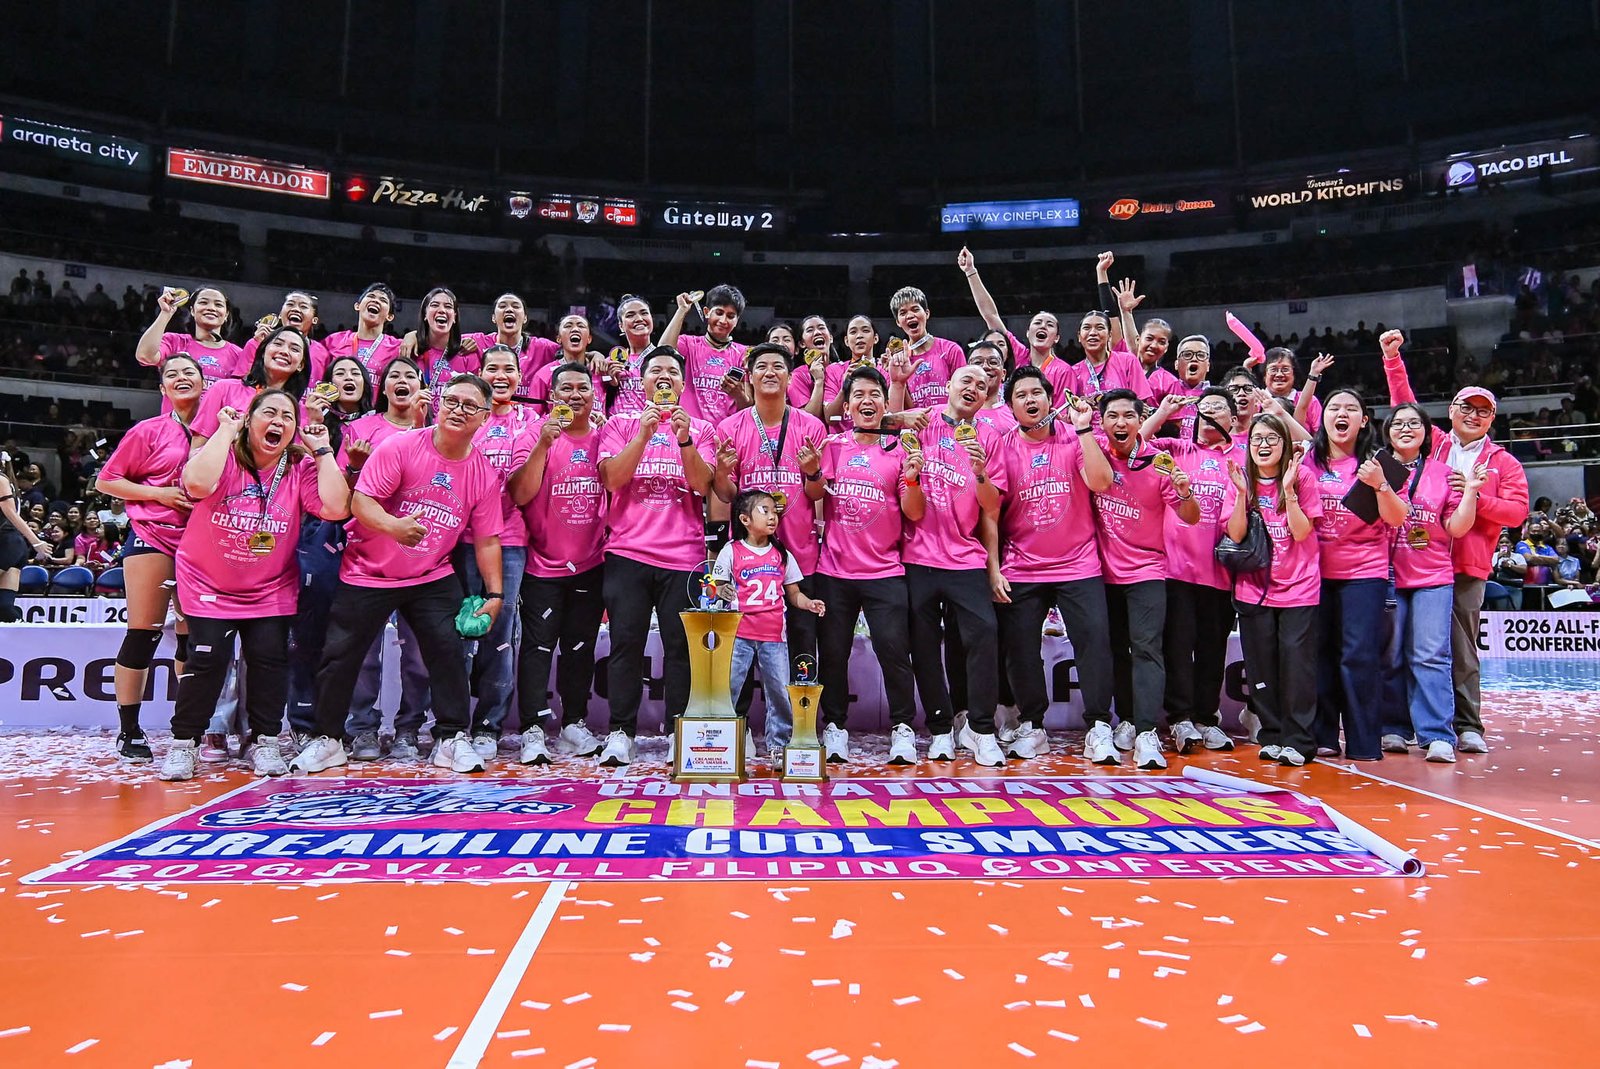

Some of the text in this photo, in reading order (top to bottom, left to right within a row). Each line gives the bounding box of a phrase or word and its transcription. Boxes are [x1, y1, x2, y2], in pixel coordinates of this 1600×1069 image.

[12, 128, 139, 166] araneta city
[183, 158, 314, 191] EMPERADOR
[1478, 157, 1524, 176] TACO
[372, 180, 489, 212] Pizza Hut
[1252, 190, 1313, 208] WORLD
[541, 208, 569, 218] Cignal
[1114, 204, 1136, 215] DQ
[1175, 200, 1215, 212] Queen
[606, 214, 633, 223] Cignal
[761, 212, 773, 228] 2
[942, 209, 1079, 225] GATEWAY CINEPLEX 18
[211, 511, 288, 534] CHAMPIONS
[399, 500, 462, 528] CHAMPIONS
[741, 564, 778, 580] Creamline
[746, 579, 780, 606] 24
[1504, 619, 1550, 634] 2026
[584, 797, 1316, 828] CHAMPIONS
[134, 832, 651, 857] CREAMLINE
[919, 828, 1363, 855] SMASHERS
[320, 861, 462, 878] PVL
[502, 860, 626, 877] ALL
[659, 859, 958, 877] FILIPINO
